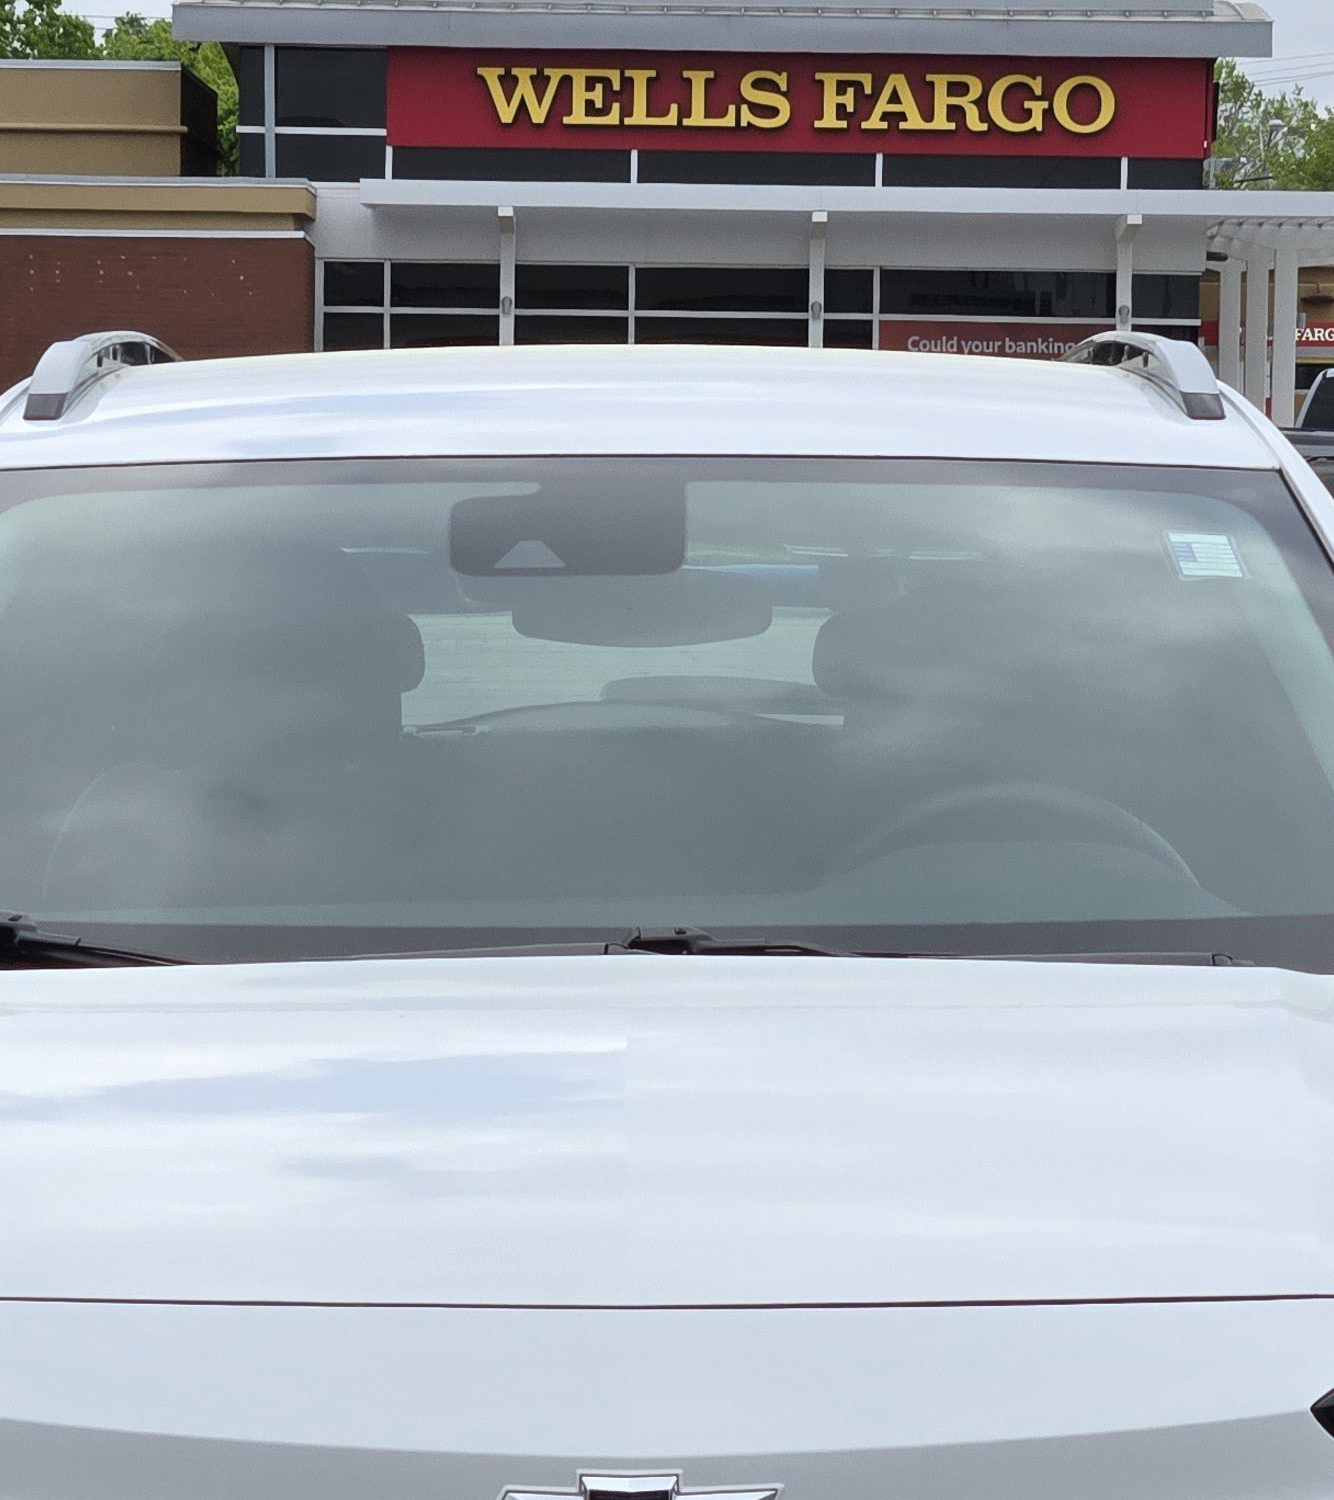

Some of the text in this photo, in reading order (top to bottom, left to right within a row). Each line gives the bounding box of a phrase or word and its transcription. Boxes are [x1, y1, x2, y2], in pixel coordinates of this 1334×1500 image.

[476, 66, 1116, 134] WELLS FARGO
[907, 335, 958, 353] Could
[960, 339, 1003, 355] your
